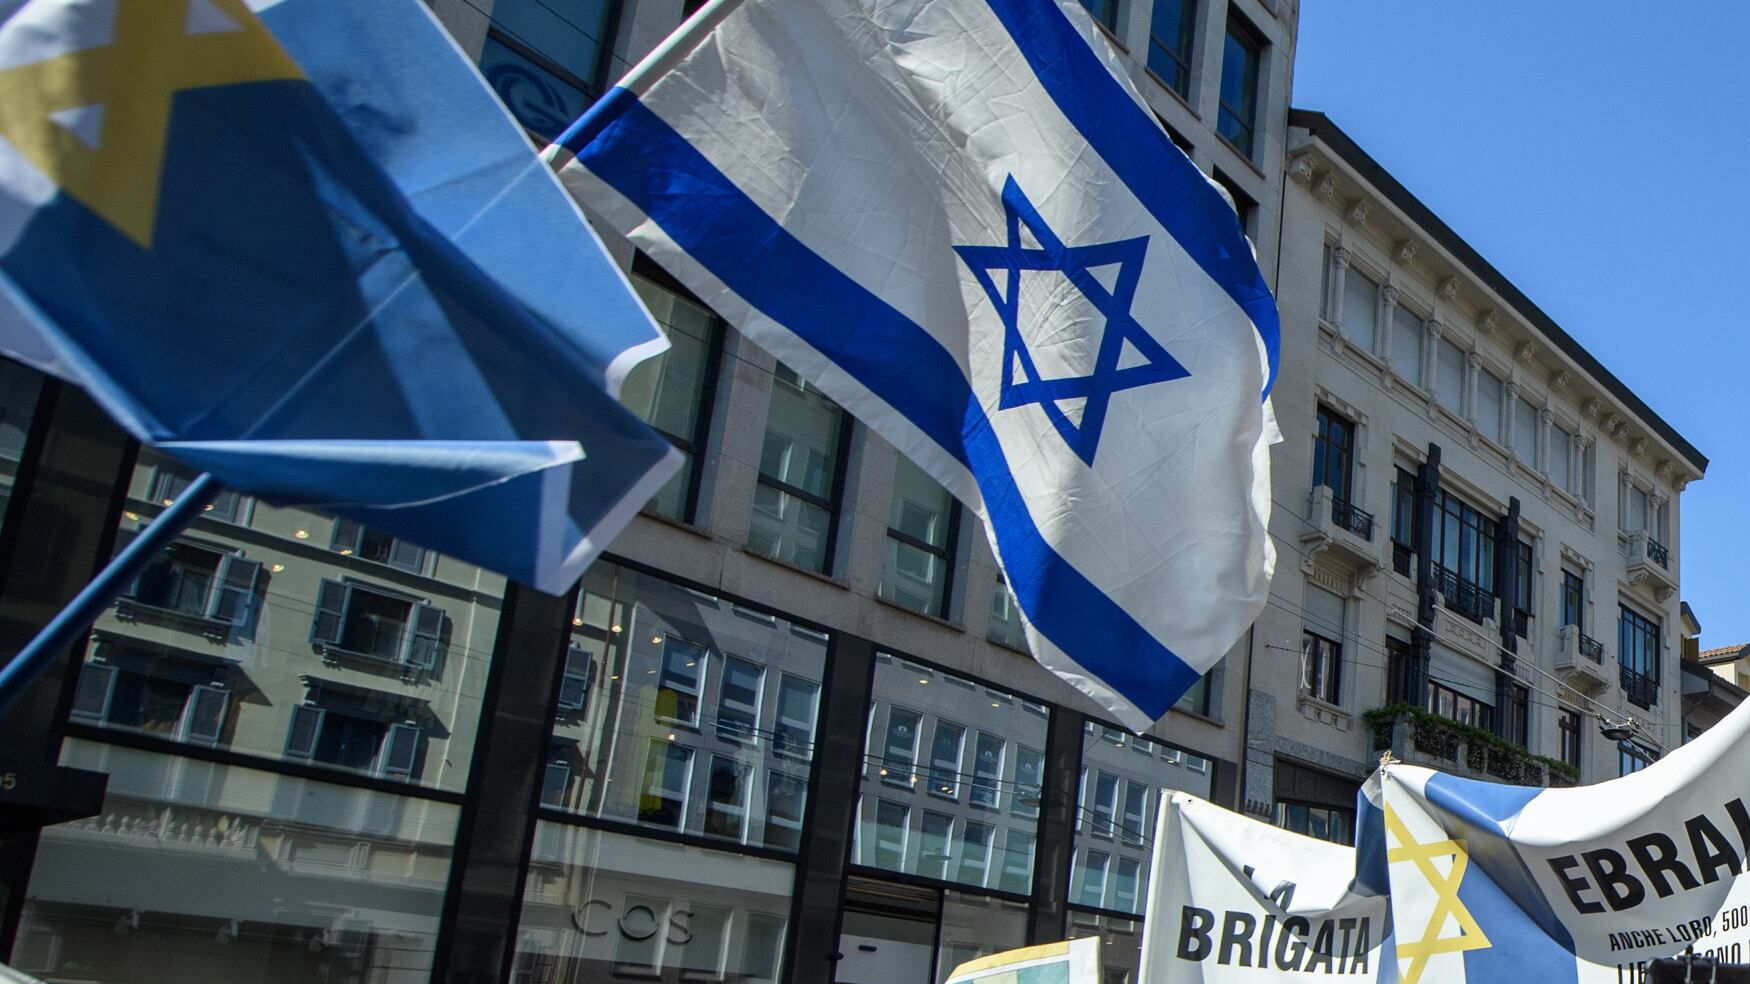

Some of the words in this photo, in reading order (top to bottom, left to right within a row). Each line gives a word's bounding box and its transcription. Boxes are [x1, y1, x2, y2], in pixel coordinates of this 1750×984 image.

[572, 900, 694, 945] COS
[1177, 905, 1370, 975] BRIGATA
[1608, 928, 1667, 952] ANCHE
[1665, 915, 1717, 943] LORO,
